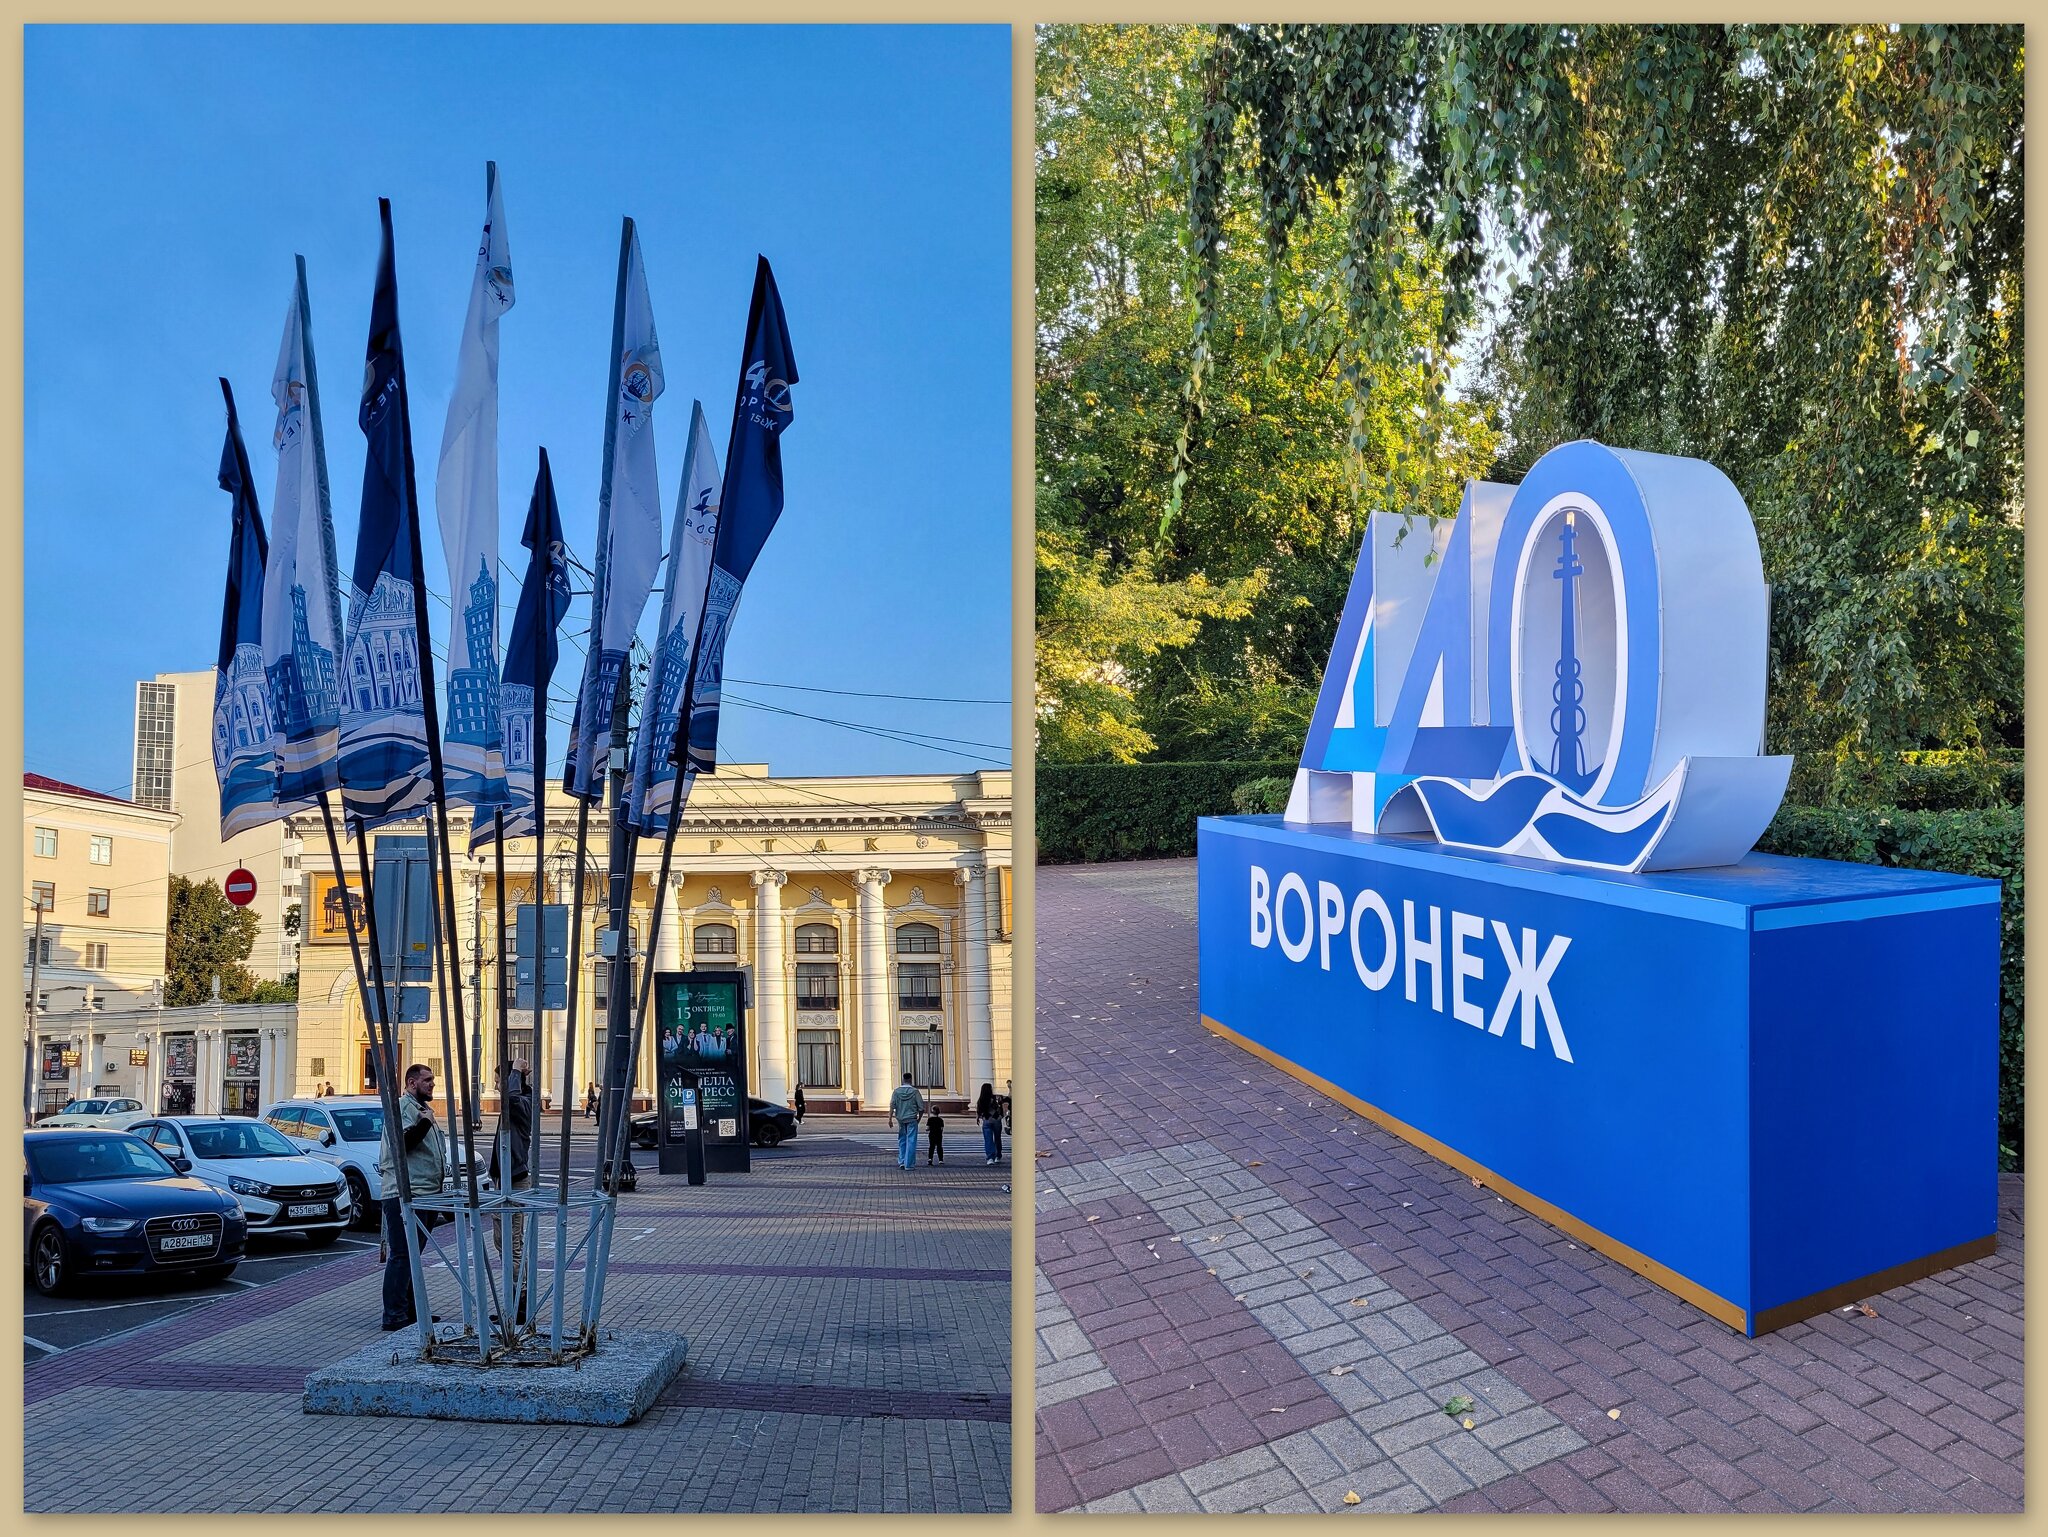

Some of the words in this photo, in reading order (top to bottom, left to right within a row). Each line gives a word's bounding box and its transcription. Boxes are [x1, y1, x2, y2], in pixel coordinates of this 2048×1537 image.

[1249, 864, 1575, 1063] ВОРОНЕЖ
[677, 1006, 691, 1020] 15
[692, 1005, 725, 1013] ОКТЯБРЯ
[163, 1237, 198, 1249] А282НЕ
[199, 1235, 212, 1244] 136
